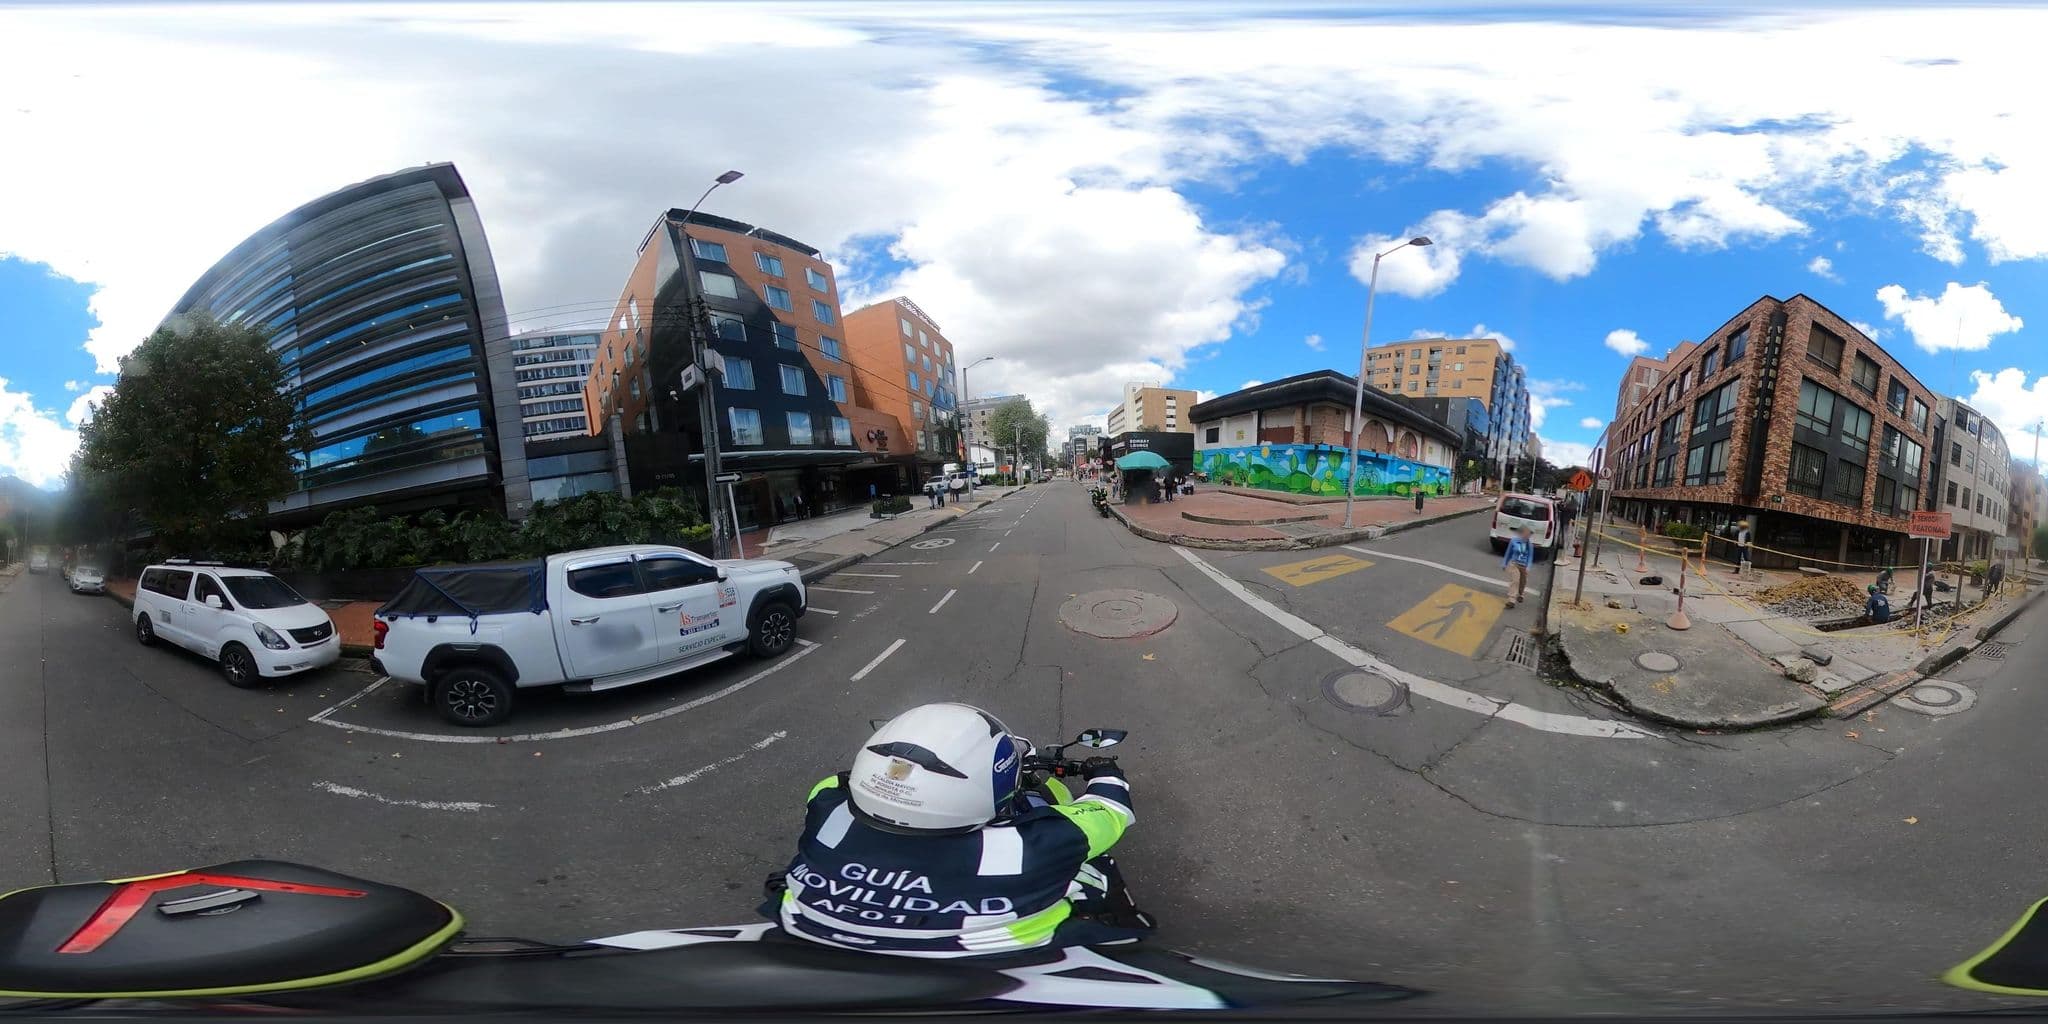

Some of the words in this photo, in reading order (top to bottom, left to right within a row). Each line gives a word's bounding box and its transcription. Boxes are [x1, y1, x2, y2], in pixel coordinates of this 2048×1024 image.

[792, 863, 1014, 914] MOVILIDAD
[840, 862, 933, 894] GUÍA
[812, 899, 906, 924] AF01
